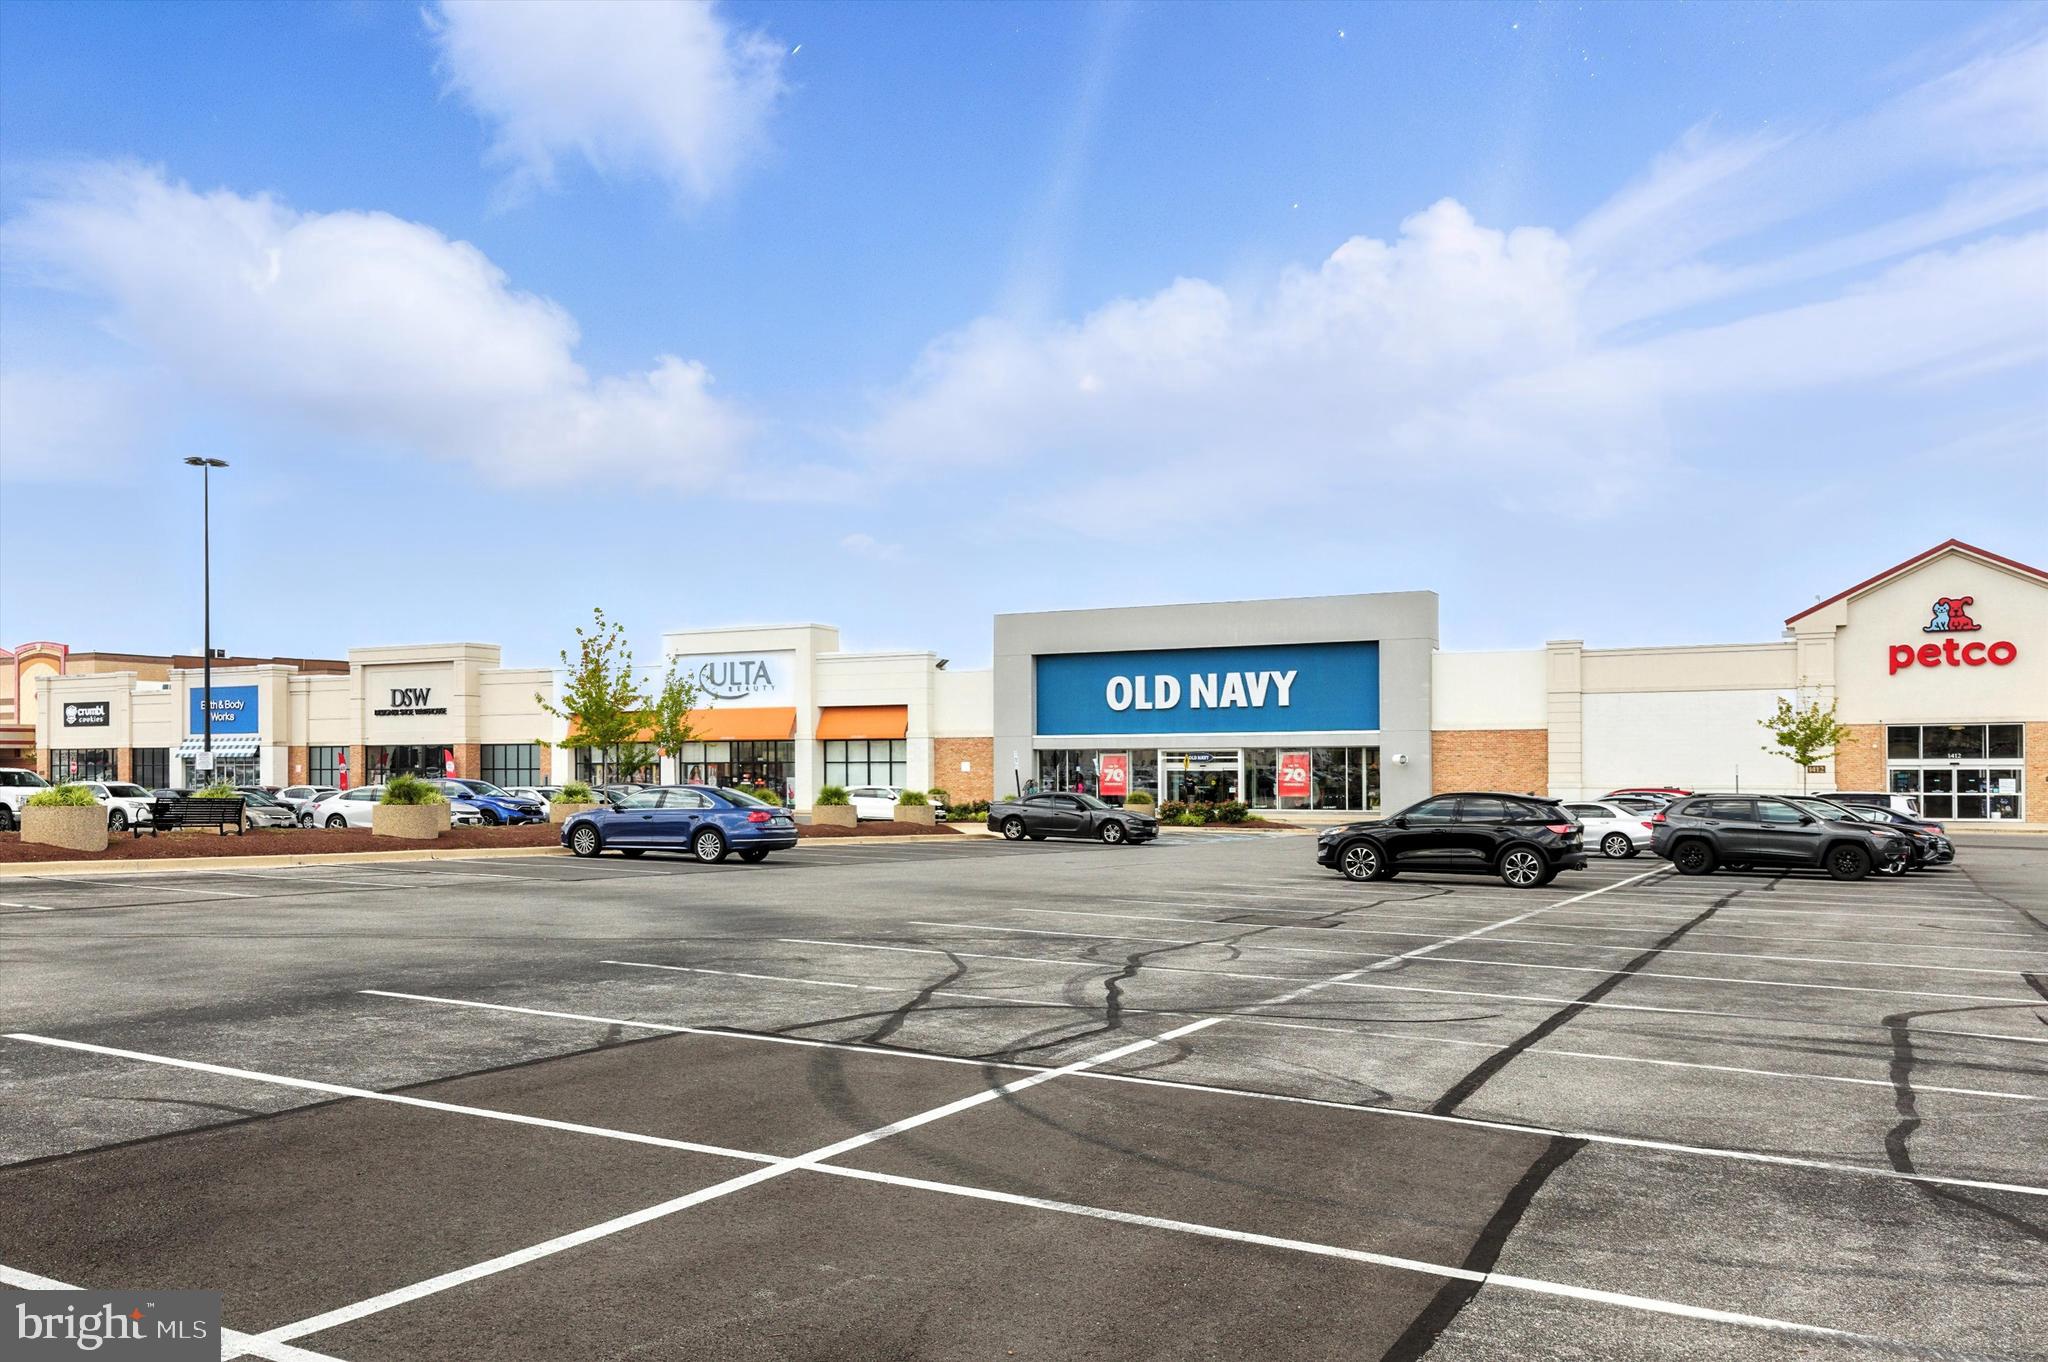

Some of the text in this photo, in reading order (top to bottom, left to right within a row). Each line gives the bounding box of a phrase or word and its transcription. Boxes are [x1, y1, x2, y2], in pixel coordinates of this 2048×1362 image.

[1889, 638, 2017, 675] petco
[709, 660, 772, 687] ULTA
[728, 684, 775, 692] BEAUTY
[1106, 670, 1298, 711] OLD NAVY
[200, 699, 244, 711] Bth & Body
[390, 687, 431, 707] DSW
[77, 705, 105, 716] crumbl
[210, 712, 235, 721] Works
